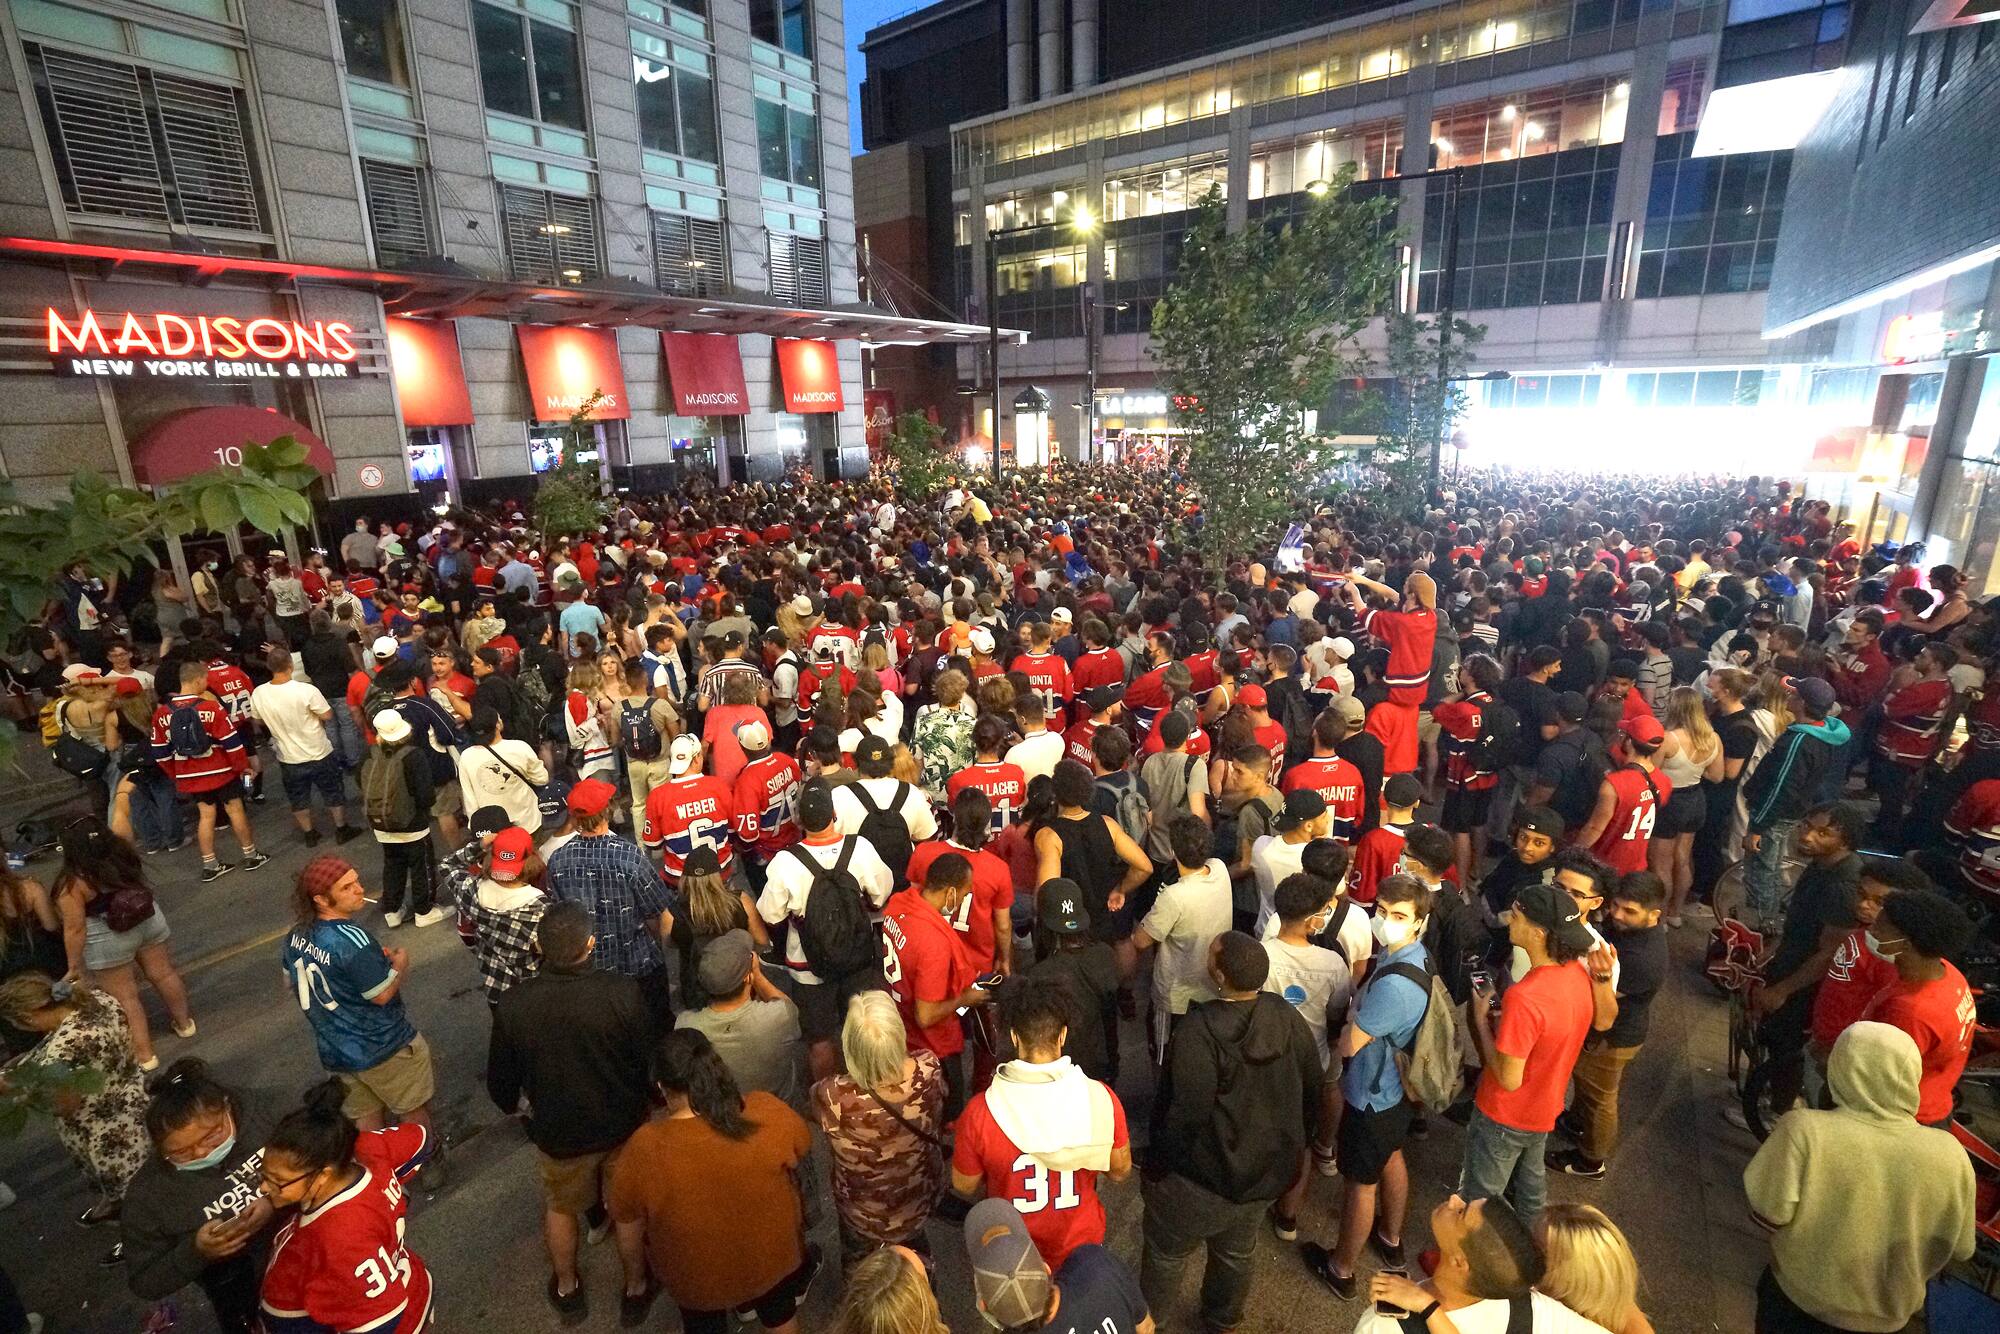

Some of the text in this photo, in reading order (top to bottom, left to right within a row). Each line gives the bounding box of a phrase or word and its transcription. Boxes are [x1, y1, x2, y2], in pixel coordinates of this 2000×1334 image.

[47, 307, 356, 361] MADISONS
[72, 359, 348, 378] NEW YORK GRILL & BAR
[686, 392, 739, 405] MADISONS
[793, 391, 837, 403] MADISONS
[223, 680, 243, 692] COLE
[1028, 675, 1053, 686] IONTA
[221, 690, 252, 723] 72
[766, 766, 793, 795] SUBBAN
[676, 798, 717, 820] WEBER
[737, 813, 758, 832] 76
[1622, 803, 1656, 840] 14
[293, 956, 340, 1012] 10
[224, 1153, 262, 1186] THE
[1012, 1153, 1080, 1214] 31
[203, 1179, 254, 1221] NOR
[231, 1187, 269, 1217] FAC
[354, 1245, 400, 1299] 31
